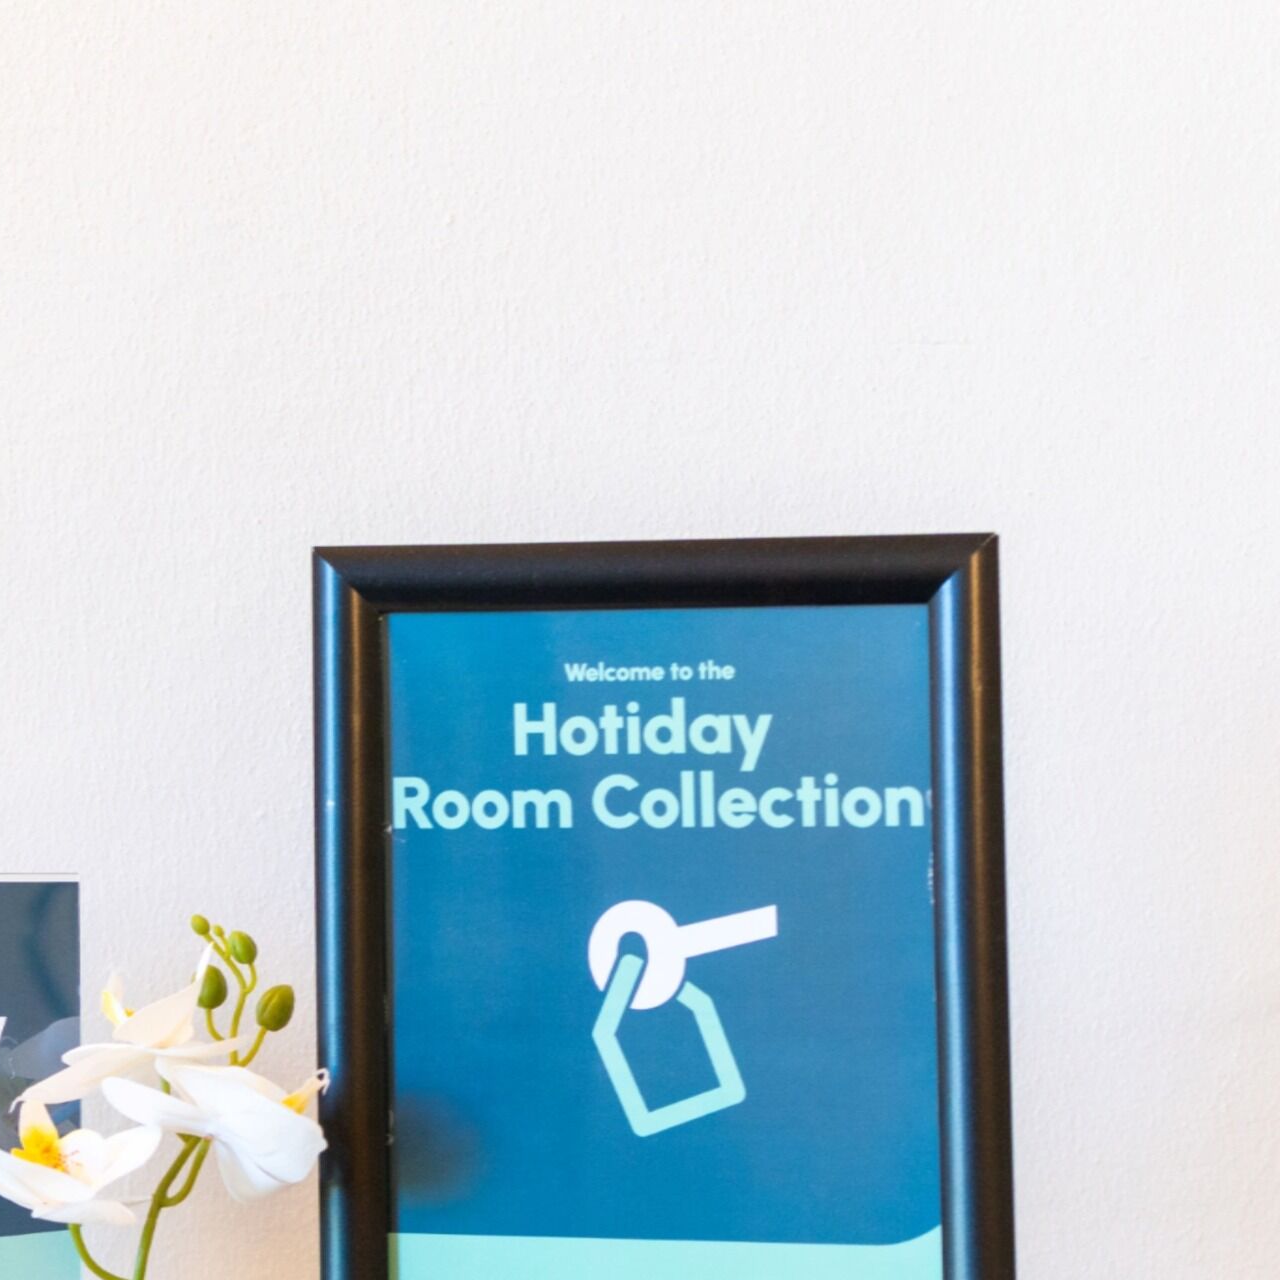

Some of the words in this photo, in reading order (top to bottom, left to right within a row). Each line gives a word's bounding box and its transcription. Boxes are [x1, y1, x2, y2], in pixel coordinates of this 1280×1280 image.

[564, 661, 664, 683] Welcome
[670, 663, 693, 681] to
[698, 659, 735, 681] the
[512, 696, 772, 772] Hotiday
[392, 776, 573, 830] Room
